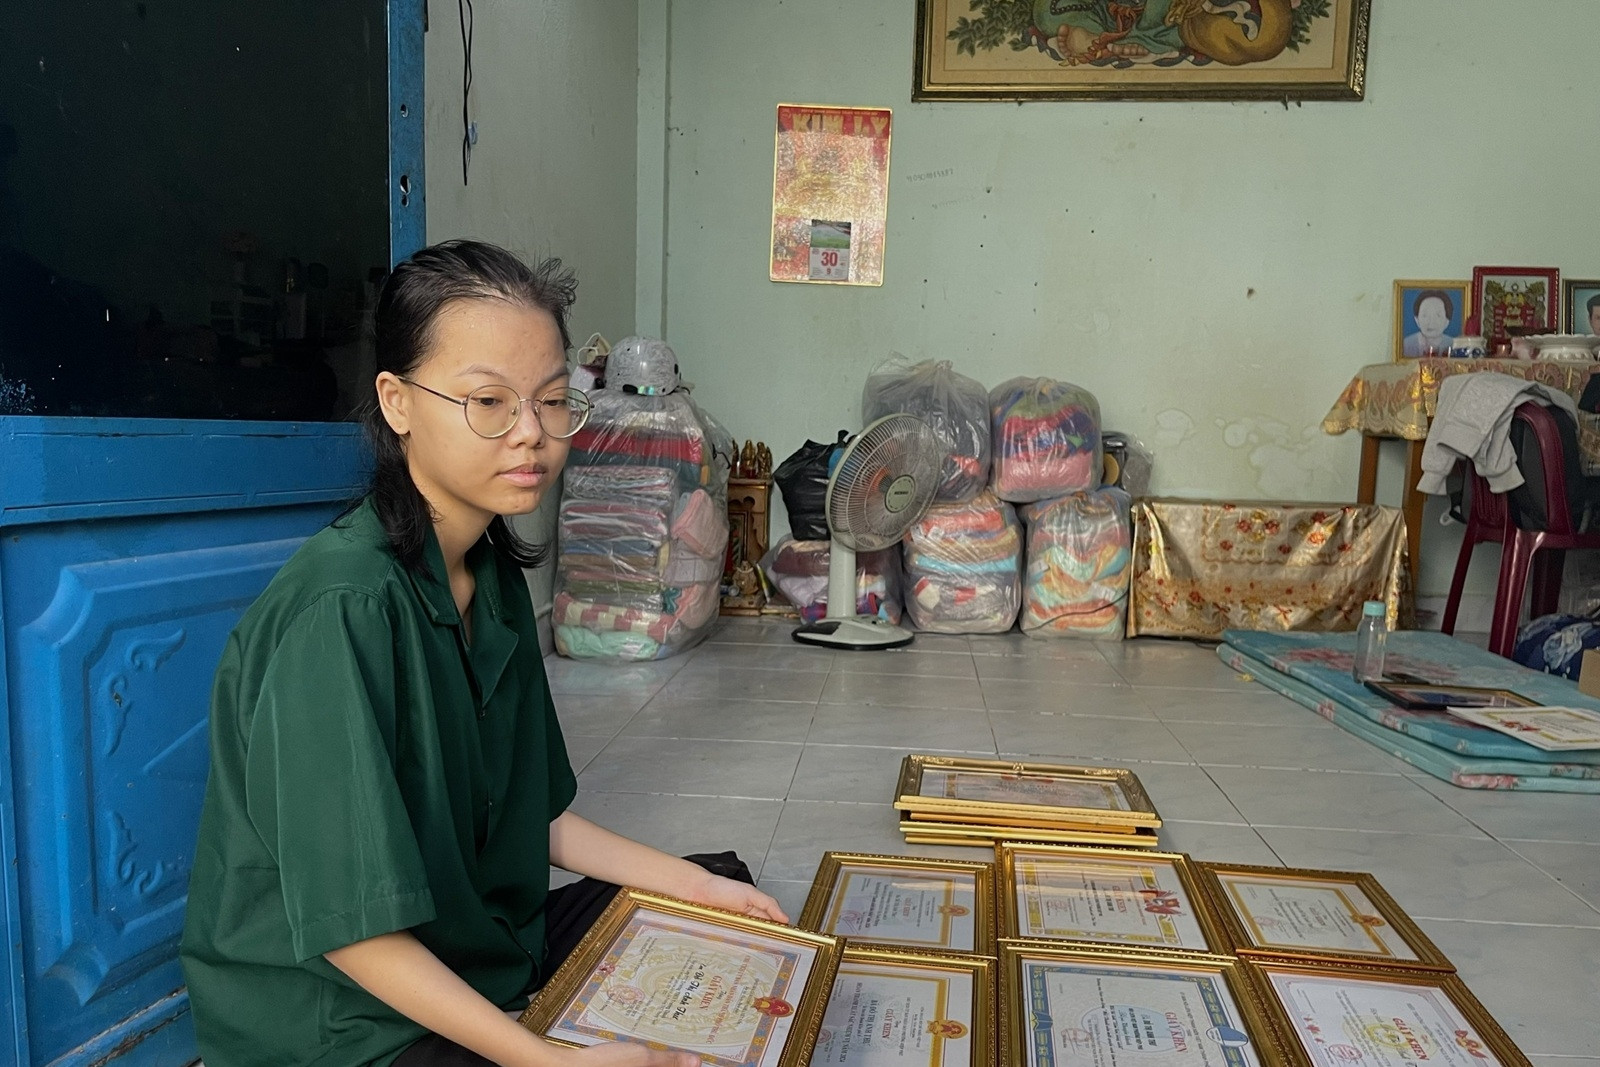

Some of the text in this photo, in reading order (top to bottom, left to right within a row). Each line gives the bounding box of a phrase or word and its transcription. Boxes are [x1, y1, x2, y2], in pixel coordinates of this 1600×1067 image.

[792, 113, 844, 133] KIM
[820, 251, 839, 267] 30
[684, 980, 700, 991] Thị
[697, 974, 723, 1010] GIẤY KHEN
[880, 1008, 896, 1038] GIẤY KHEN
[1170, 1030, 1187, 1052] KHEN
[1391, 1017, 1415, 1035] GIẤY
[1405, 1038, 1430, 1060] KHEN
